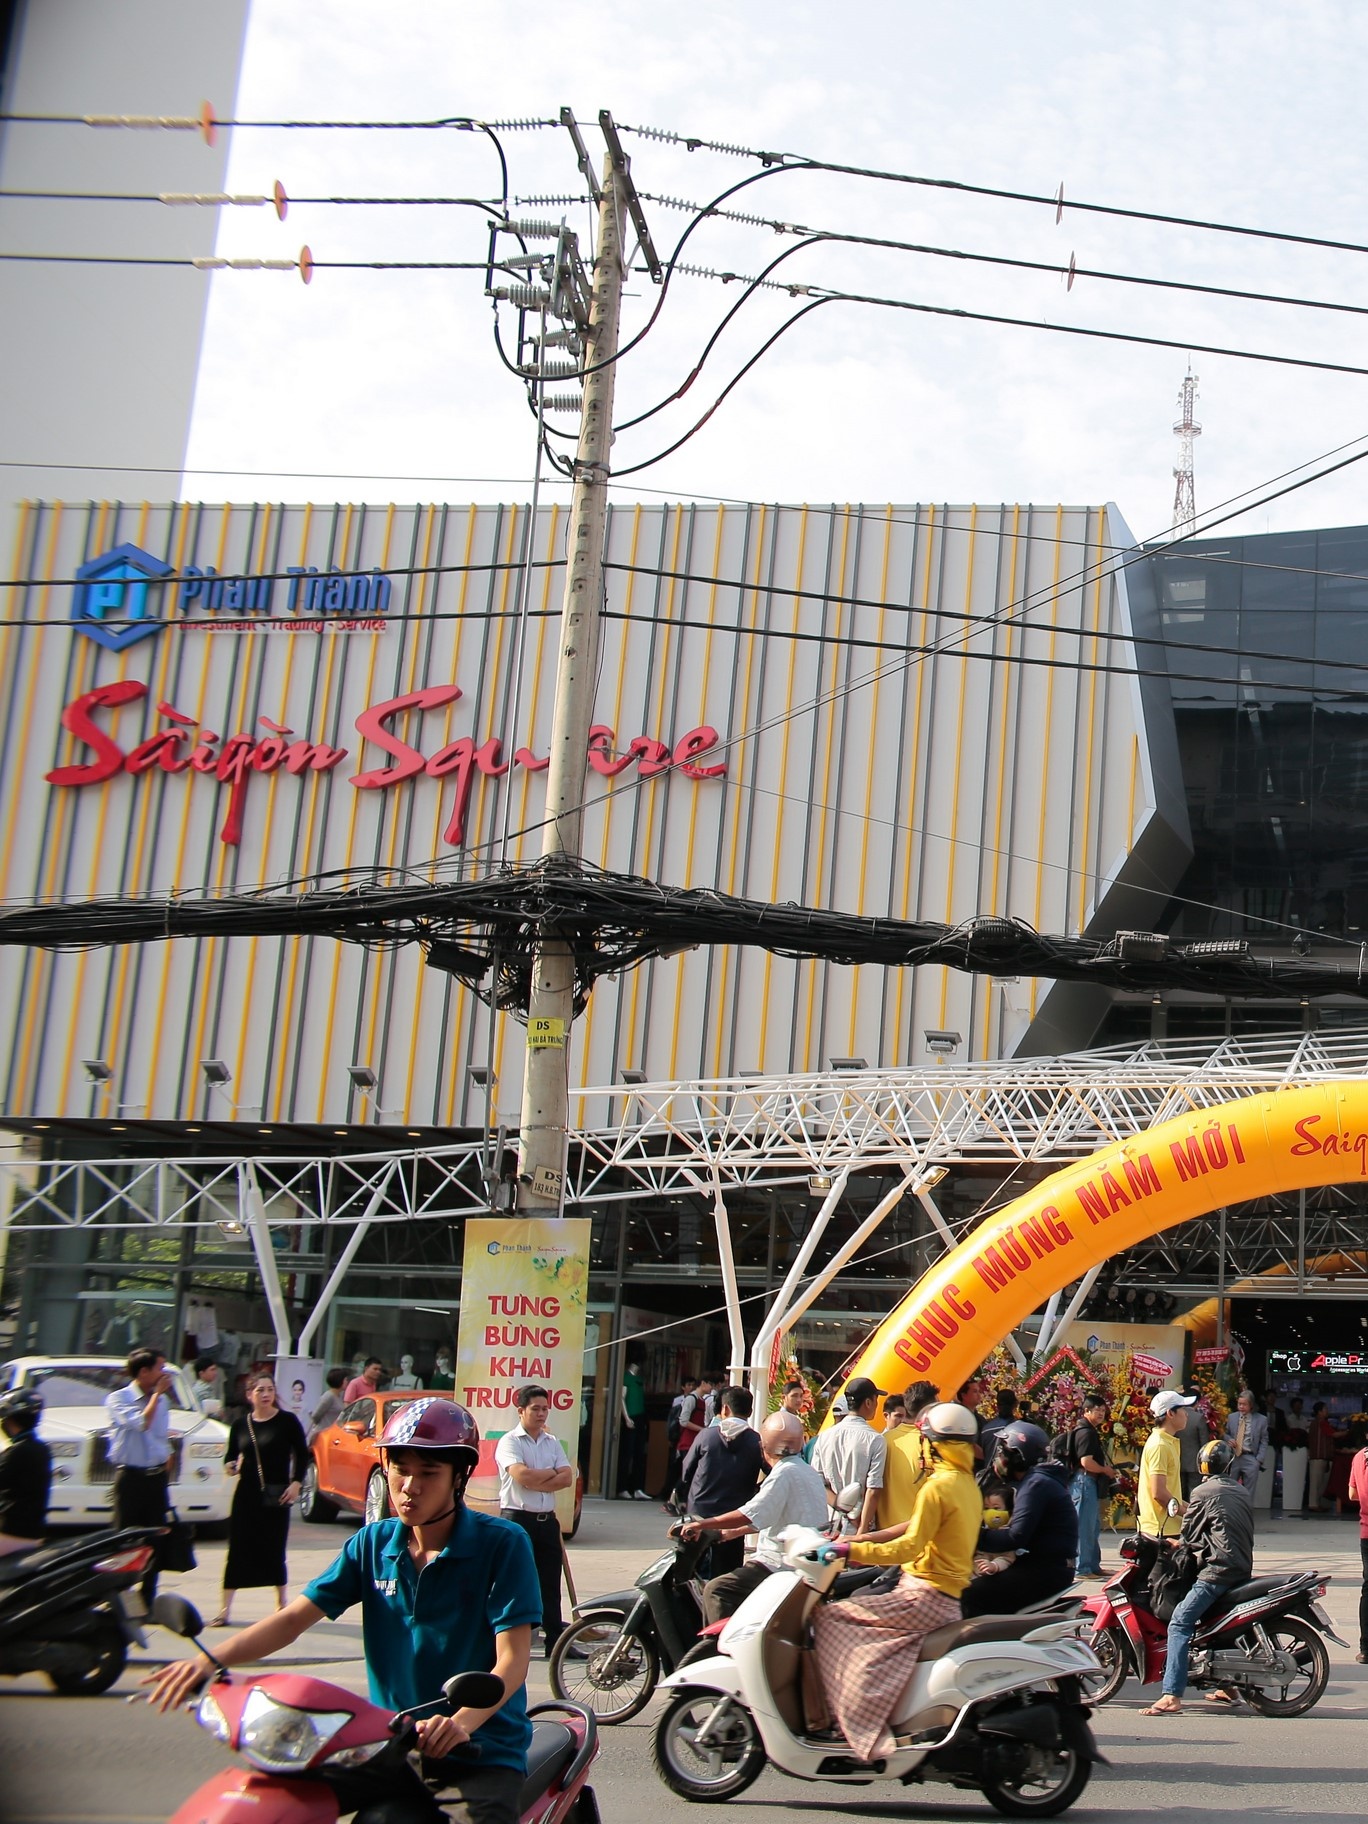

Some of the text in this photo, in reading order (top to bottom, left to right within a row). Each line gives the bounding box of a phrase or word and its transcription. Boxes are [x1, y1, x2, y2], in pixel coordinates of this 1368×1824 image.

[286, 565, 392, 613] Thành
[536, 1020, 550, 1031] DS
[1075, 1153, 1163, 1226] NĂM
[1169, 1119, 1246, 1183] MỚI
[488, 1293, 560, 1318] TƯNG
[485, 1320, 560, 1348] BỪNG
[490, 1356, 552, 1378] KHAI
[1272, 1352, 1285, 1360] Shop
[1310, 1354, 1348, 1368] Apple
